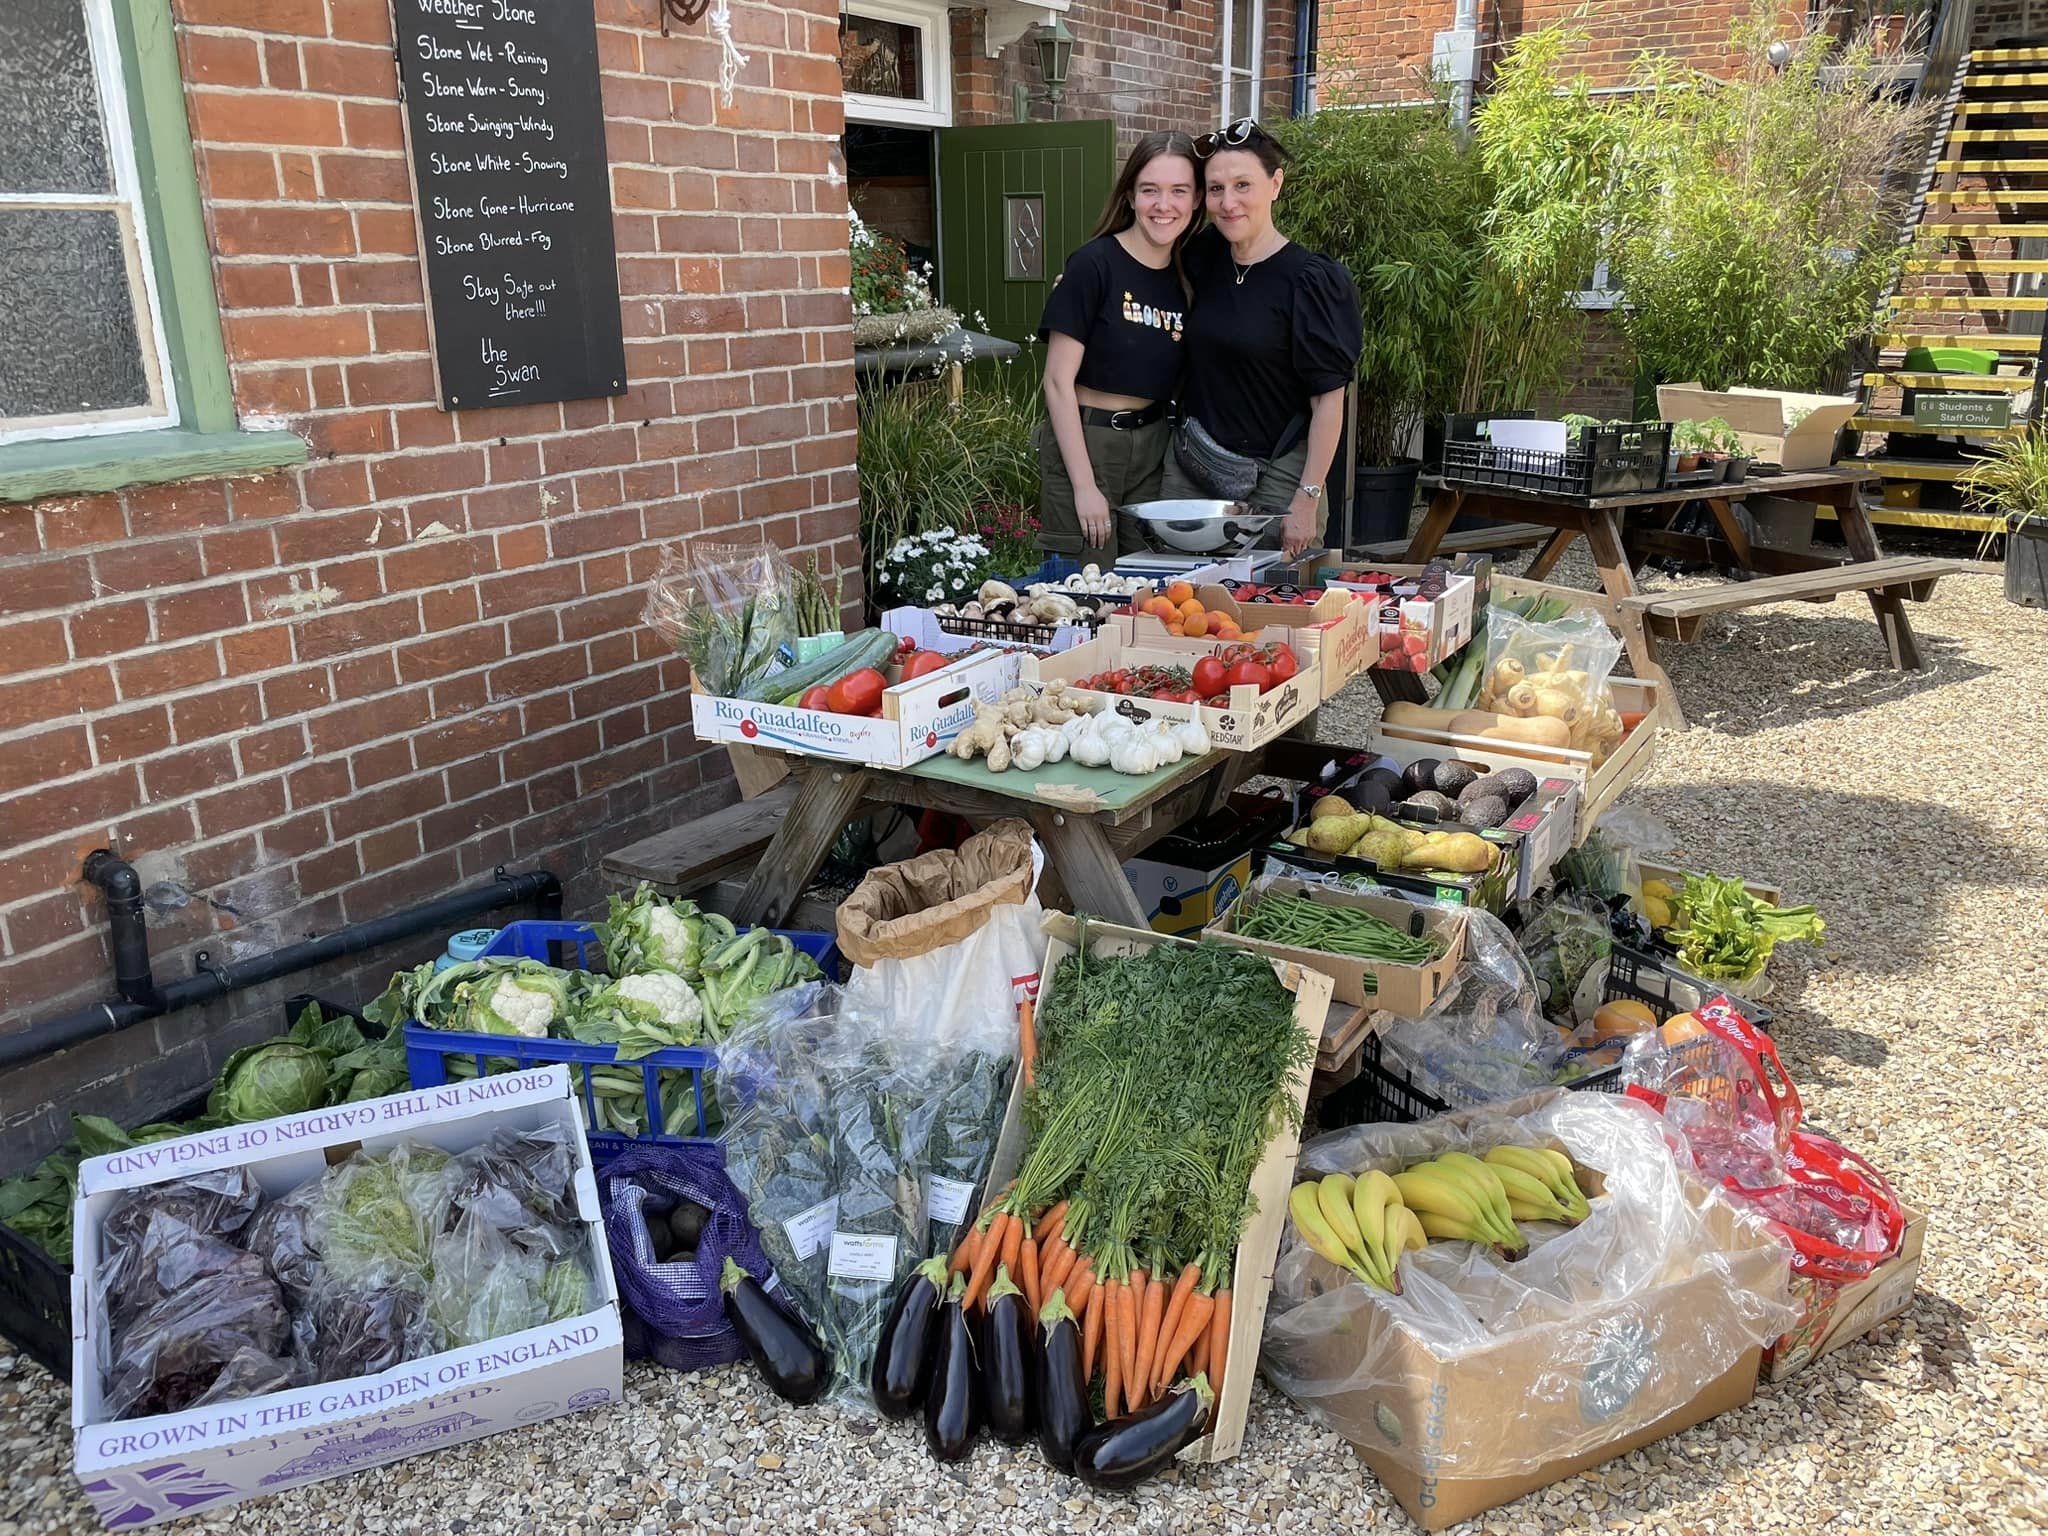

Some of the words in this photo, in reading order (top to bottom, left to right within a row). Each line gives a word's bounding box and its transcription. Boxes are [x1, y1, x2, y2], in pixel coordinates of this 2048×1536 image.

[492, 0, 536, 24] Stone
[417, 34, 463, 60] Stone
[467, 40, 494, 62] Wet
[422, 72, 465, 97] Stone
[466, 77, 497, 97] Warm
[508, 77, 545, 106] Sunny
[426, 112, 465, 133] Stone
[430, 152, 473, 174] Stone
[475, 153, 511, 172] White
[522, 151, 568, 179] Snowing
[433, 196, 474, 220] Stone
[435, 235, 475, 255] Stone
[463, 274, 499, 305] Stay
[503, 272, 534, 299] Safe
[538, 279, 557, 292] out
[505, 299, 546, 321] there!!!
[1122, 300, 1184, 331] GROOVY
[481, 337, 508, 364] the
[495, 364, 541, 386] Swan
[1938, 402, 1983, 412] Students
[1985, 403, 1993, 412] &
[1940, 413, 1963, 422] Staff
[1965, 414, 1990, 424] Only
[714, 701, 744, 720] Rio
[750, 706, 842, 736] Guadalfeo
[910, 724, 929, 742] Rio
[1210, 730, 1243, 745] REDSTAR
[436, 1089, 462, 1109] IN
[468, 1073, 553, 1102] GROWN
[381, 1095, 430, 1120] THE
[275, 1107, 376, 1142] GARDEN
[238, 1129, 269, 1150] OF
[106, 1135, 233, 1175] ENGLAND
[98, 1421, 209, 1457] GROWN
[216, 1413, 248, 1436] IN
[255, 1400, 313, 1426] THE
[319, 1371, 431, 1414] GARDEN
[437, 1361, 471, 1384] OF
[476, 1325, 599, 1374] ENGLAND
[302, 1406, 416, 1441] BETTS
